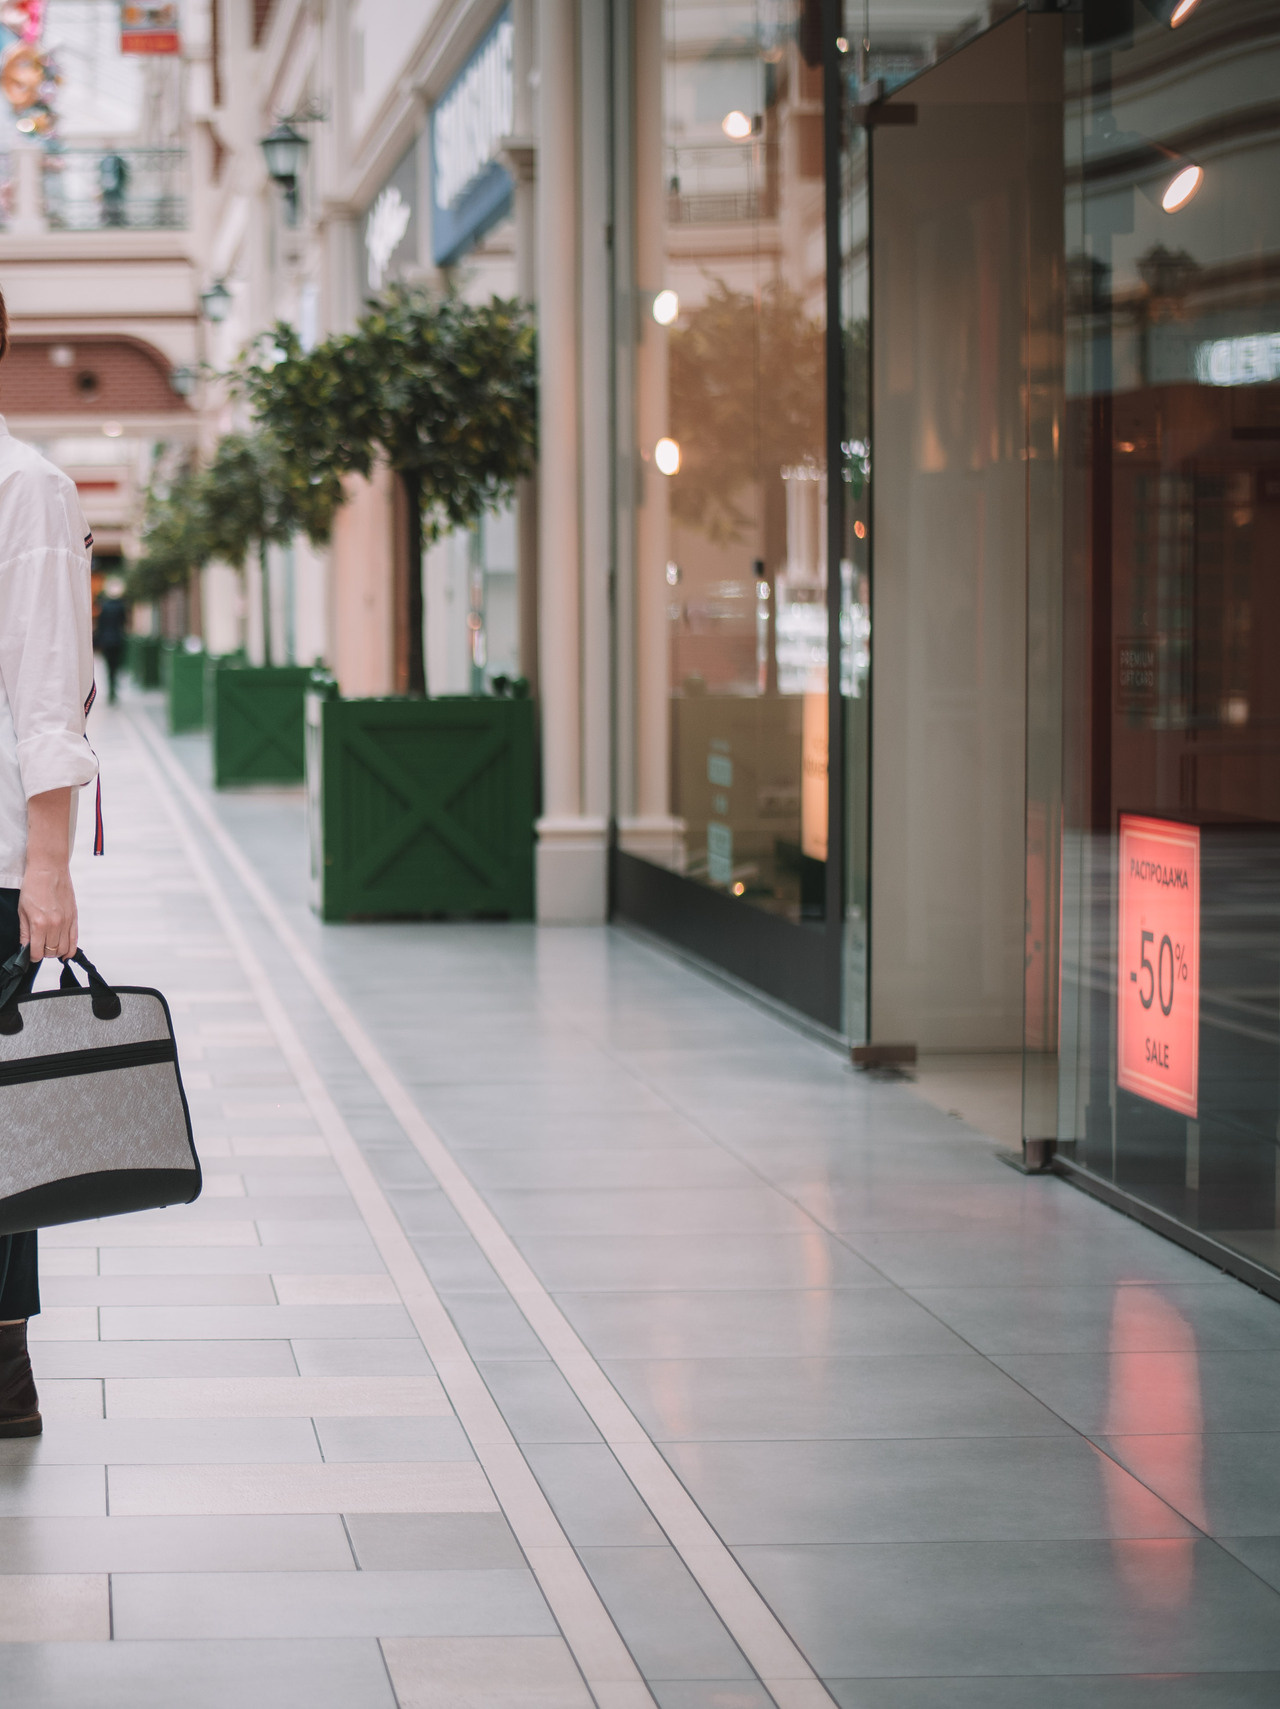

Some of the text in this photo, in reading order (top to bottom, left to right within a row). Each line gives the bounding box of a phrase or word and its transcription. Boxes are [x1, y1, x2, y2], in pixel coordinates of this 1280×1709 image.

[1130, 857, 1189, 890] РАСПРОДАЖА
[1130, 929, 1188, 1017] -50%
[1145, 1037, 1170, 1069] SALE
